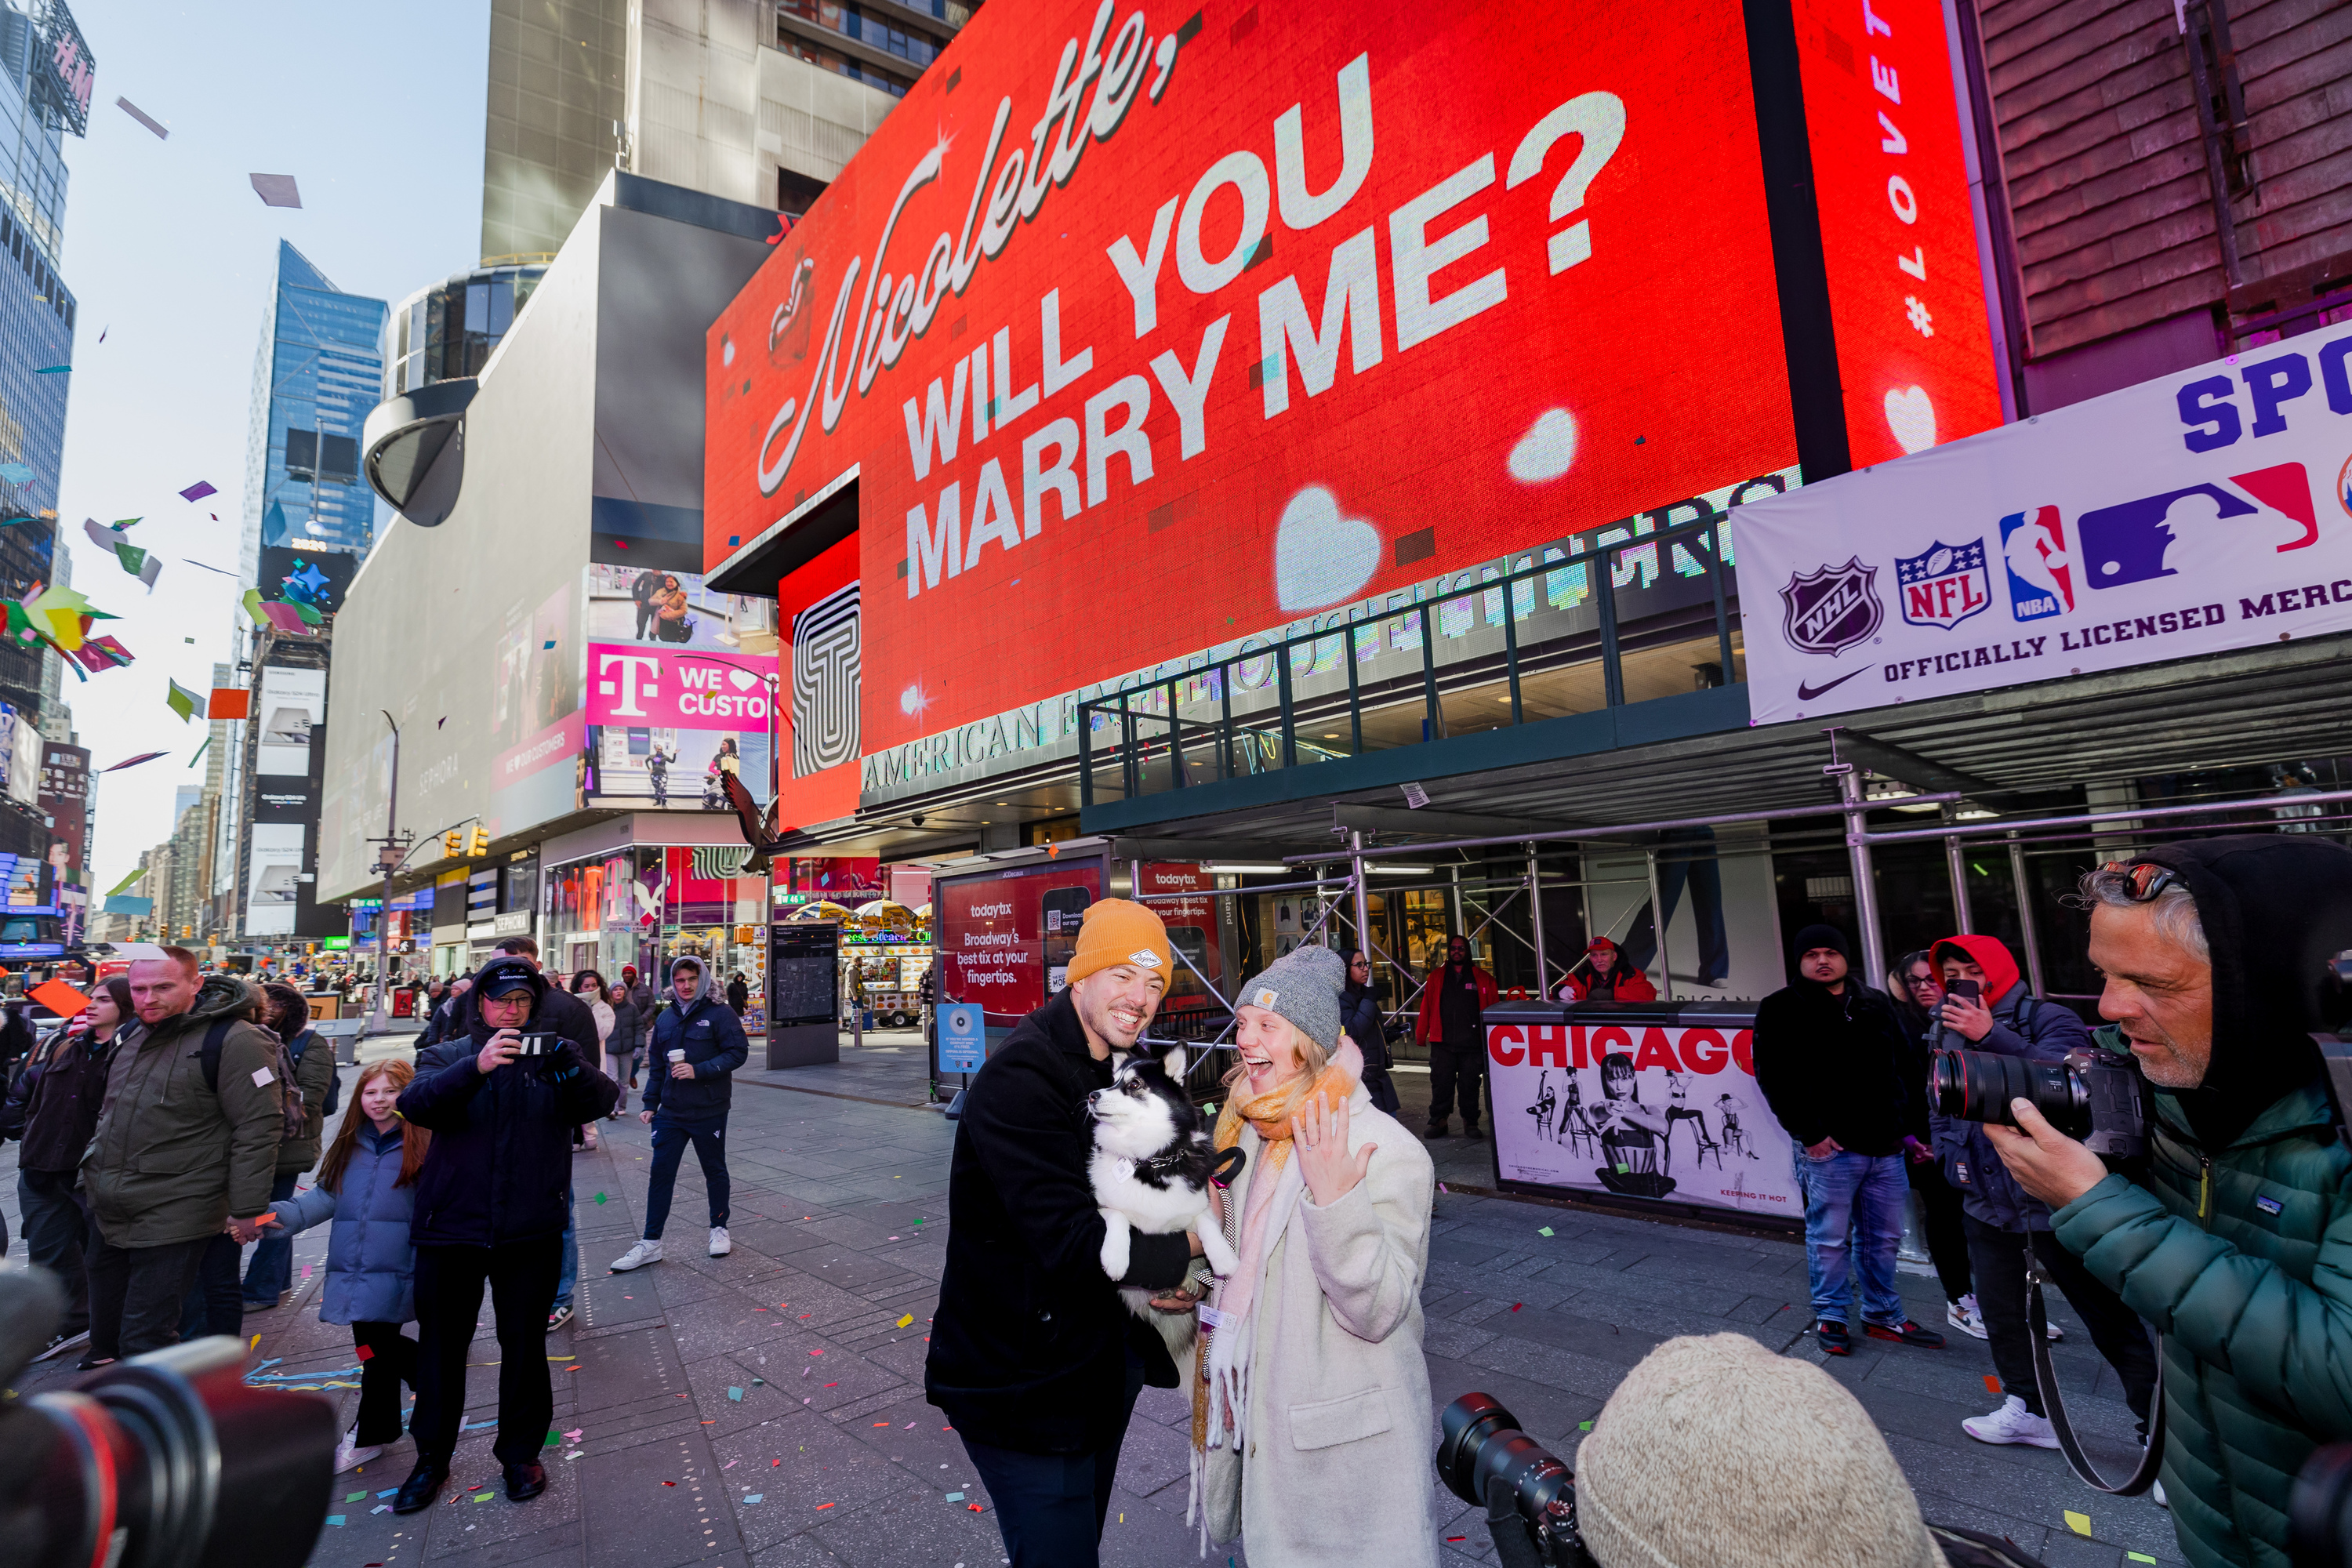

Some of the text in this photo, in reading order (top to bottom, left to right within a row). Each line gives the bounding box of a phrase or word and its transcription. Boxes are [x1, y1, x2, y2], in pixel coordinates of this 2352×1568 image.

[53, 31, 93, 114] H&M
[758, 0, 1178, 497] Nicolette,
[903, 51, 1374, 482] WILL YOU
[906, 90, 1628, 600] MARRY ME?
[1907, 573, 1984, 620] NFL
[2016, 596, 2056, 619] NBA
[1802, 581, 1860, 641] NHL
[1884, 636, 2048, 683] OFFICIALLY
[2061, 604, 2226, 653] LICENSED
[678, 666, 723, 691] WE
[861, 701, 1044, 793] AMERICAN
[1057, 649, 1213, 735] EAGLE
[419, 752, 459, 797] SEPHORA
[1002, 870, 1024, 879] JCDecaux
[1155, 873, 1196, 887] todaytix
[782, 895, 788, 903] W
[790, 895, 798, 903] 46
[970, 902, 1012, 919] todaytix
[496, 913, 527, 932] SEPHORA
[1174, 907, 1207, 918] fingertips.
[957, 950, 1029, 967] best tix at your
[967, 969, 1018, 987] fingertips.
[1720, 1189, 1757, 1200] KEEPING
